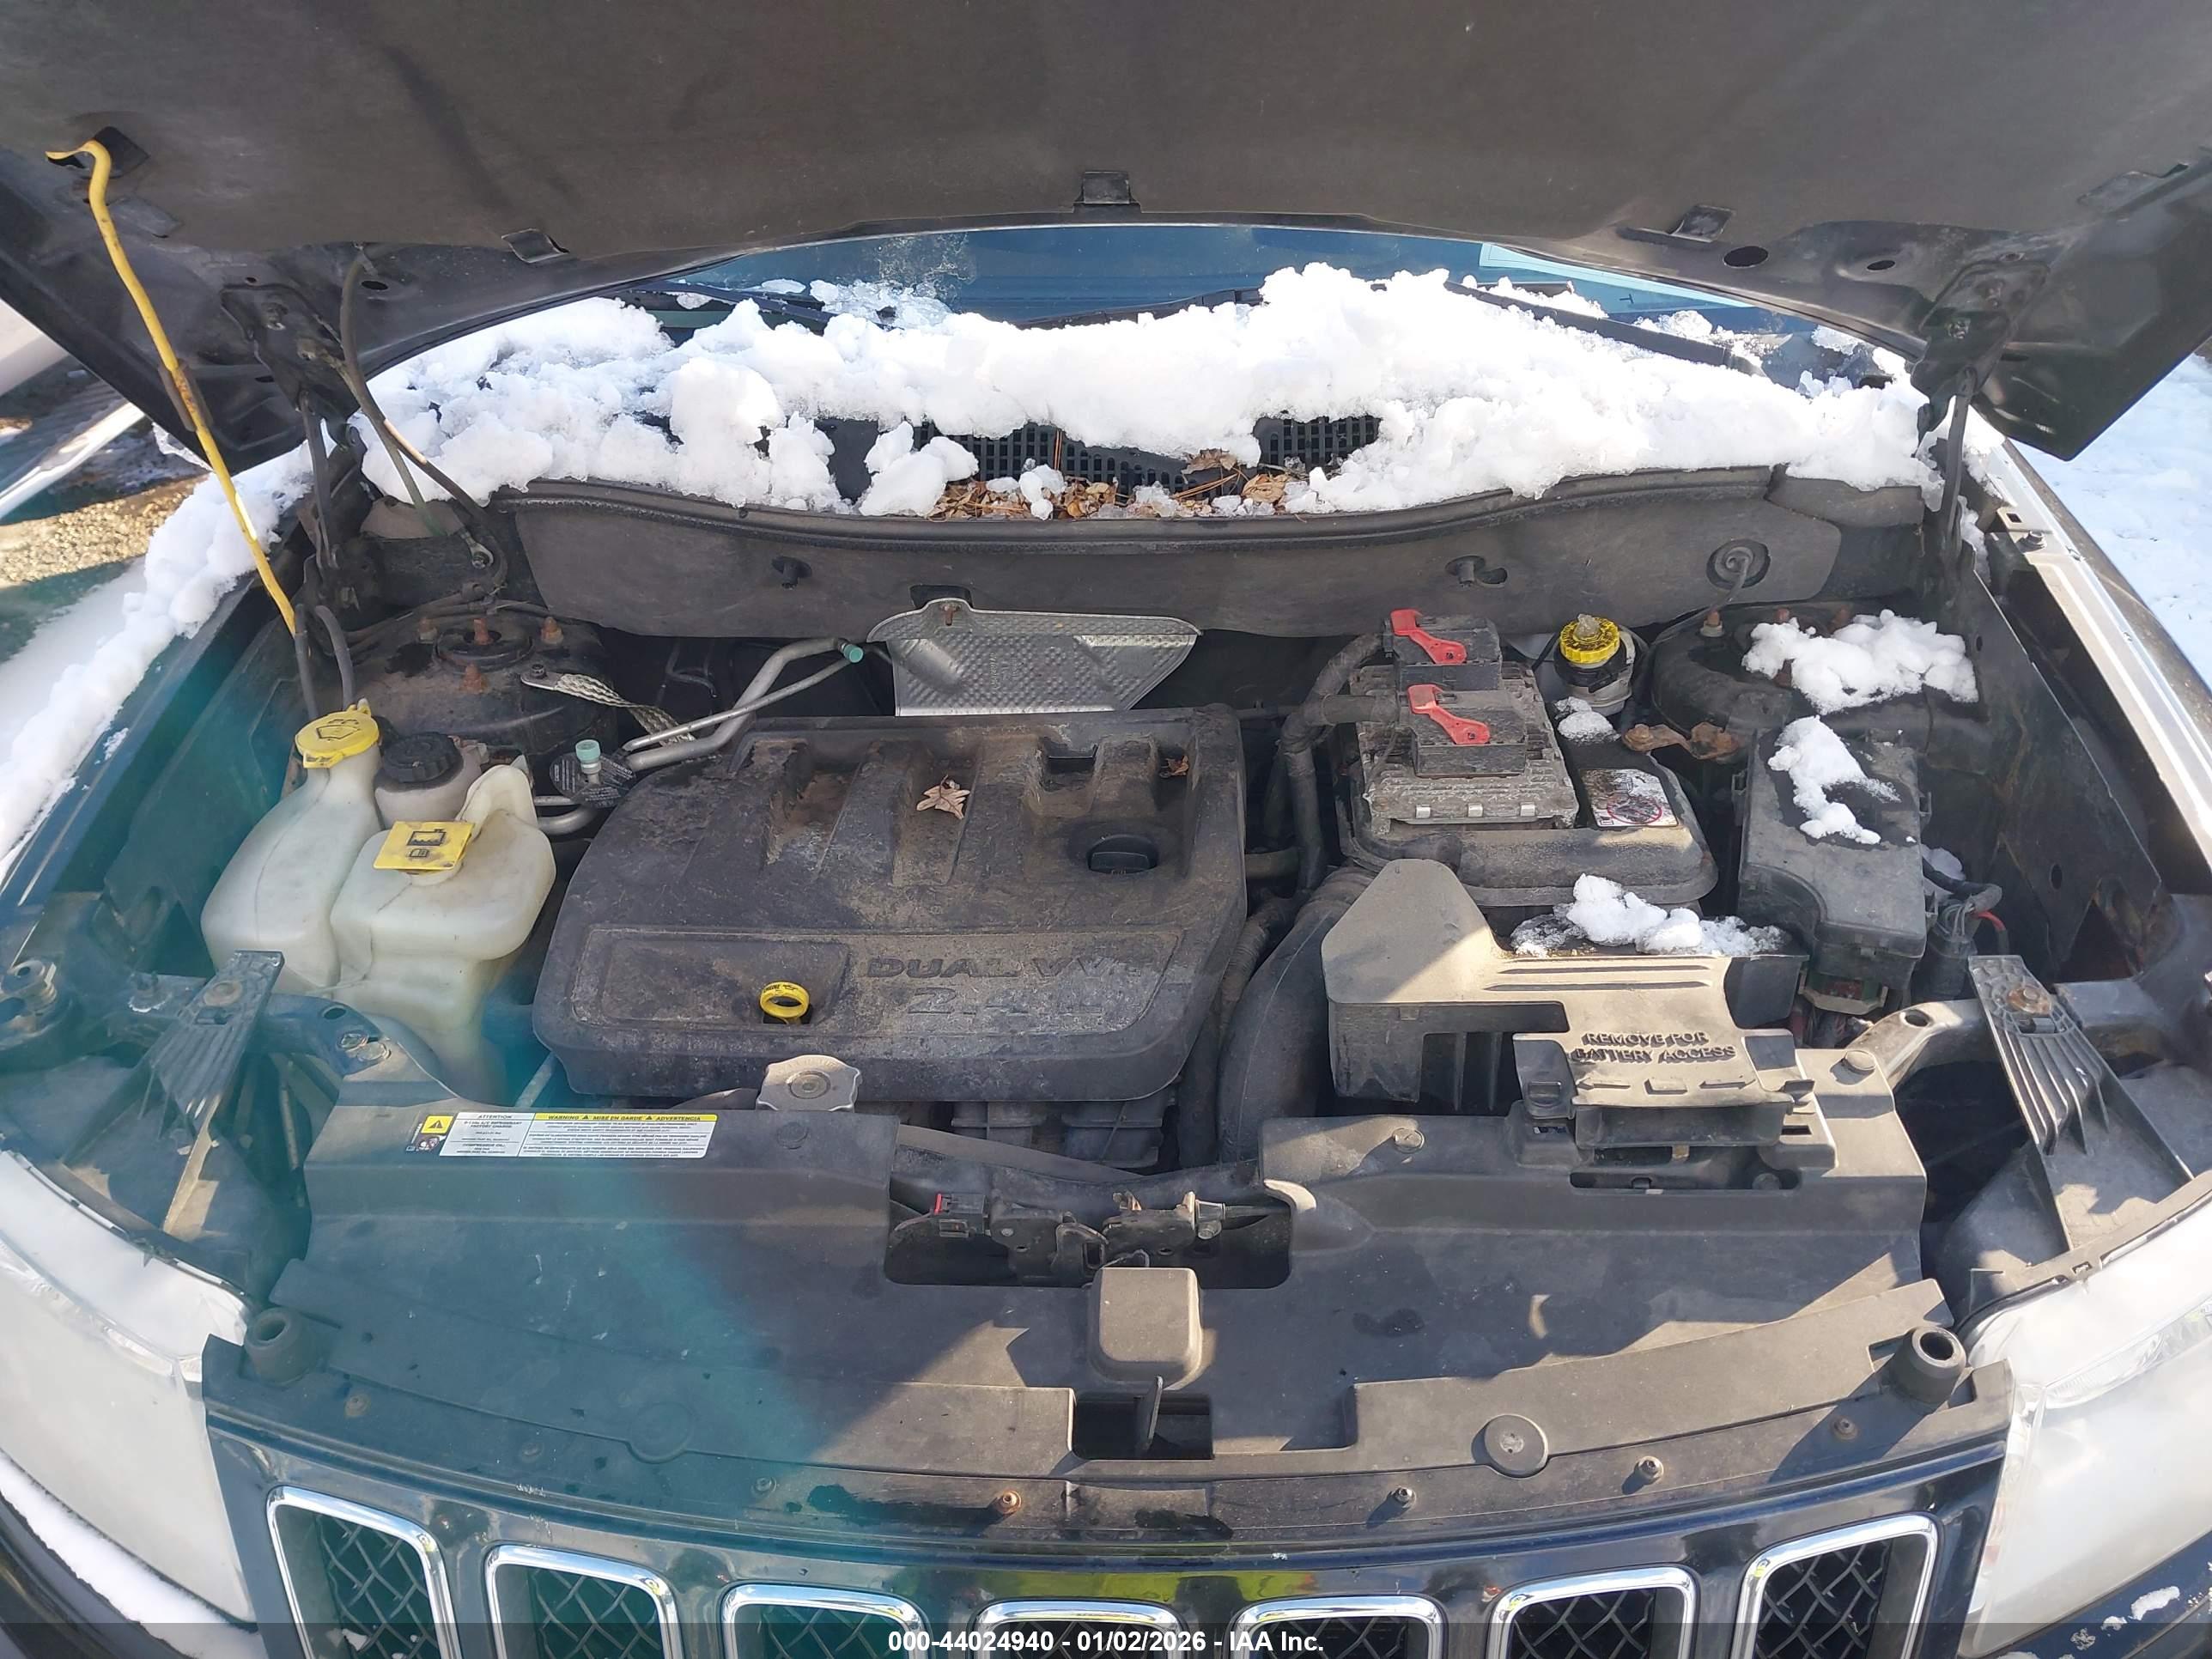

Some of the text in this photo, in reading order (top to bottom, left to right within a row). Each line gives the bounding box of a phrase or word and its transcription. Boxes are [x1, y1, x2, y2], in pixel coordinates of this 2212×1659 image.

[867, 957, 1020, 978] DUAL
[1581, 1030, 1710, 1048] REMOVE FOR
[1570, 1045, 1736, 1064] BATTERY ACCESS
